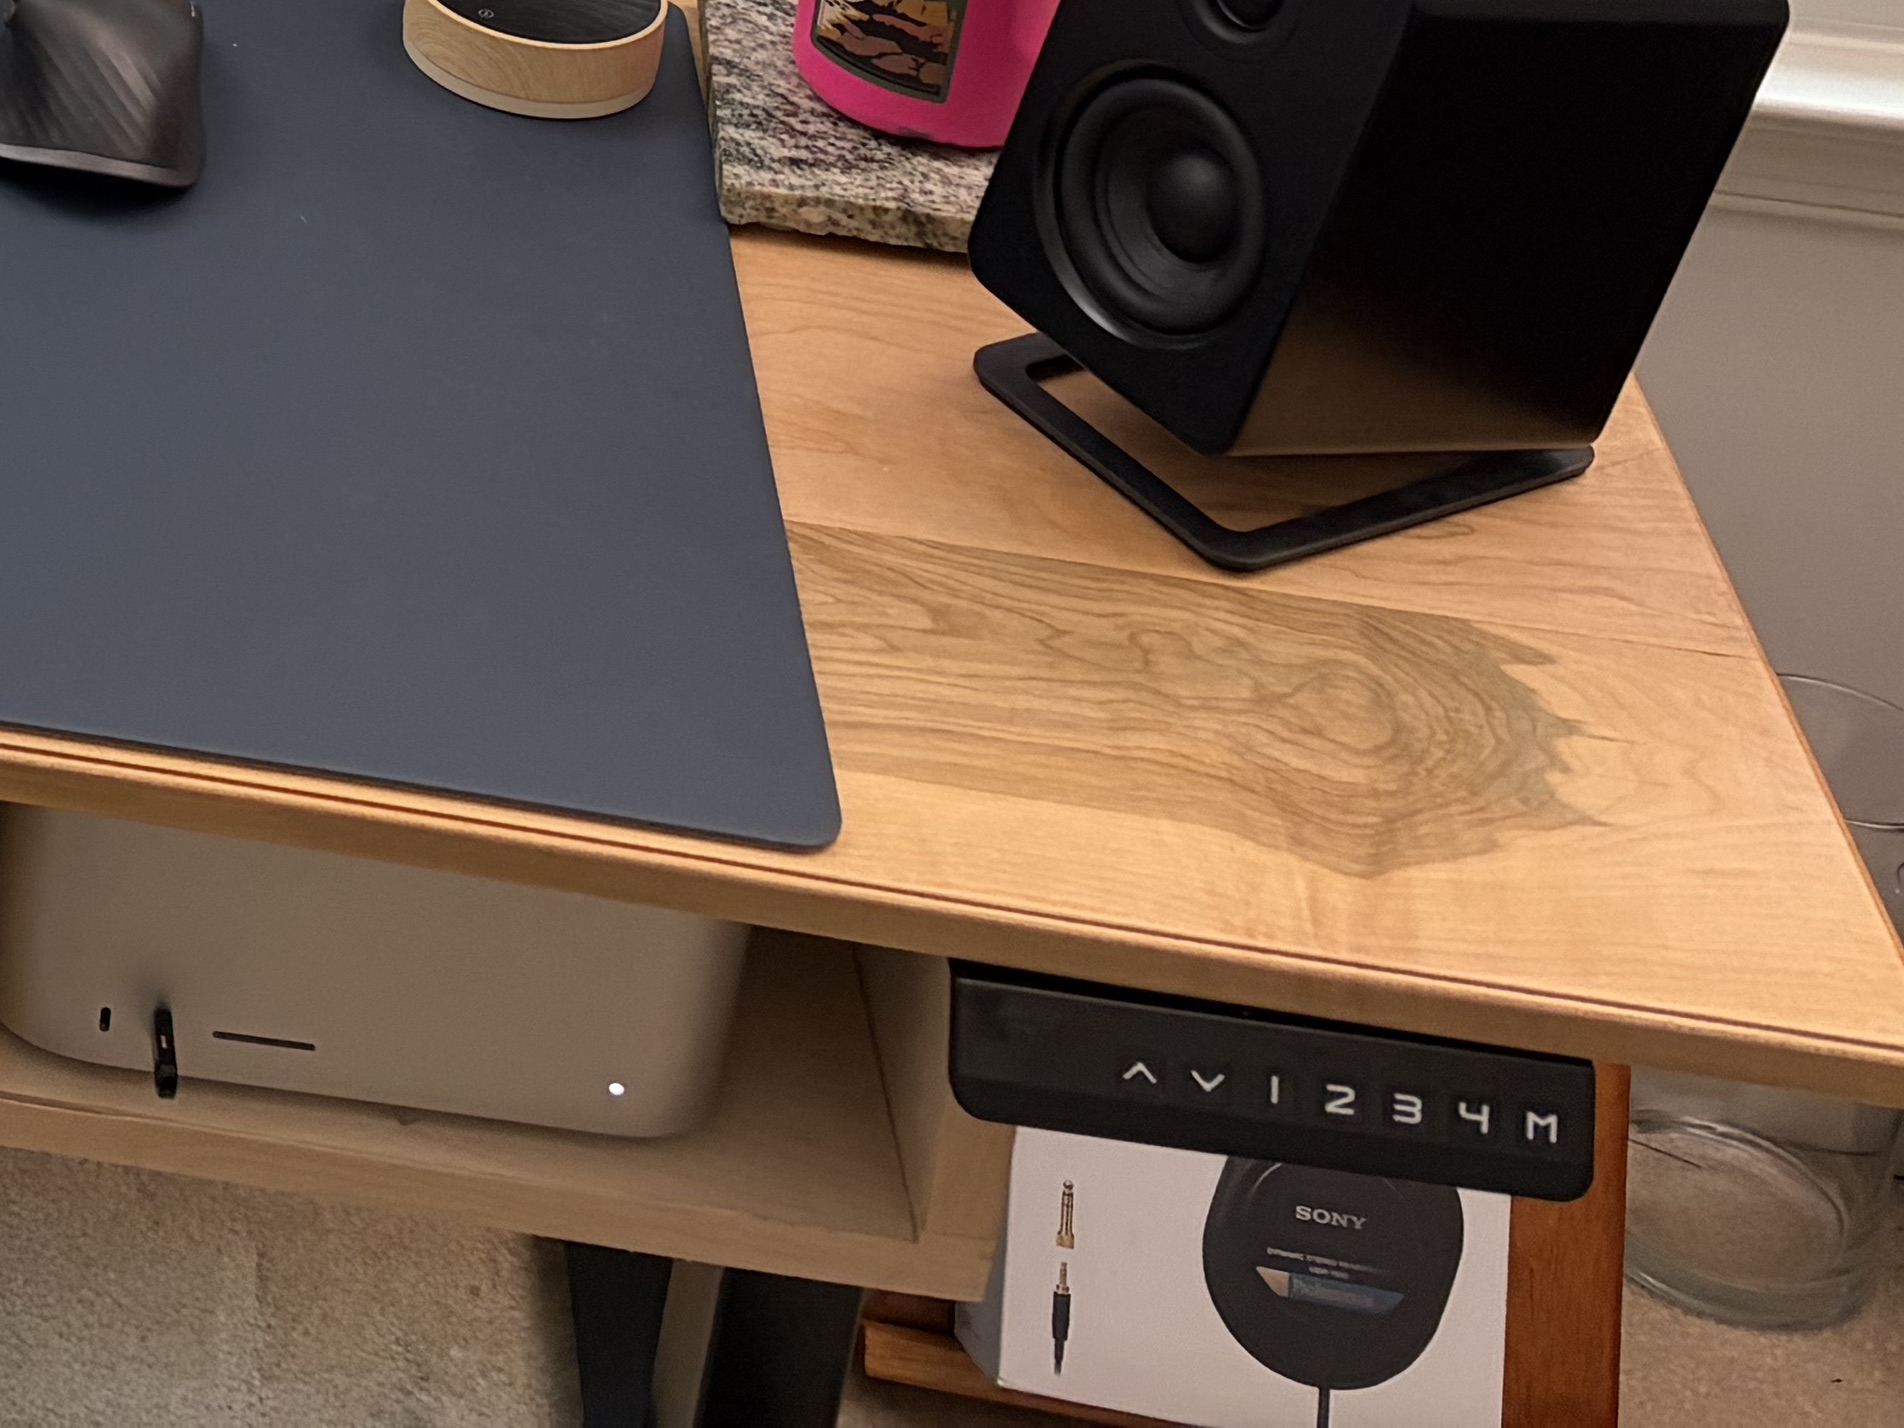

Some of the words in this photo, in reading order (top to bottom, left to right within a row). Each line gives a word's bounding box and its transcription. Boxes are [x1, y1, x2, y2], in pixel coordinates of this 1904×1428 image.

[1269, 1074, 1281, 1105] 1
[1325, 1084, 1357, 1117] 2
[1392, 1093, 1422, 1125] 3
[1458, 1101, 1491, 1136] 4
[1527, 1110, 1559, 1145] M
[1295, 1205, 1367, 1230] SONY
